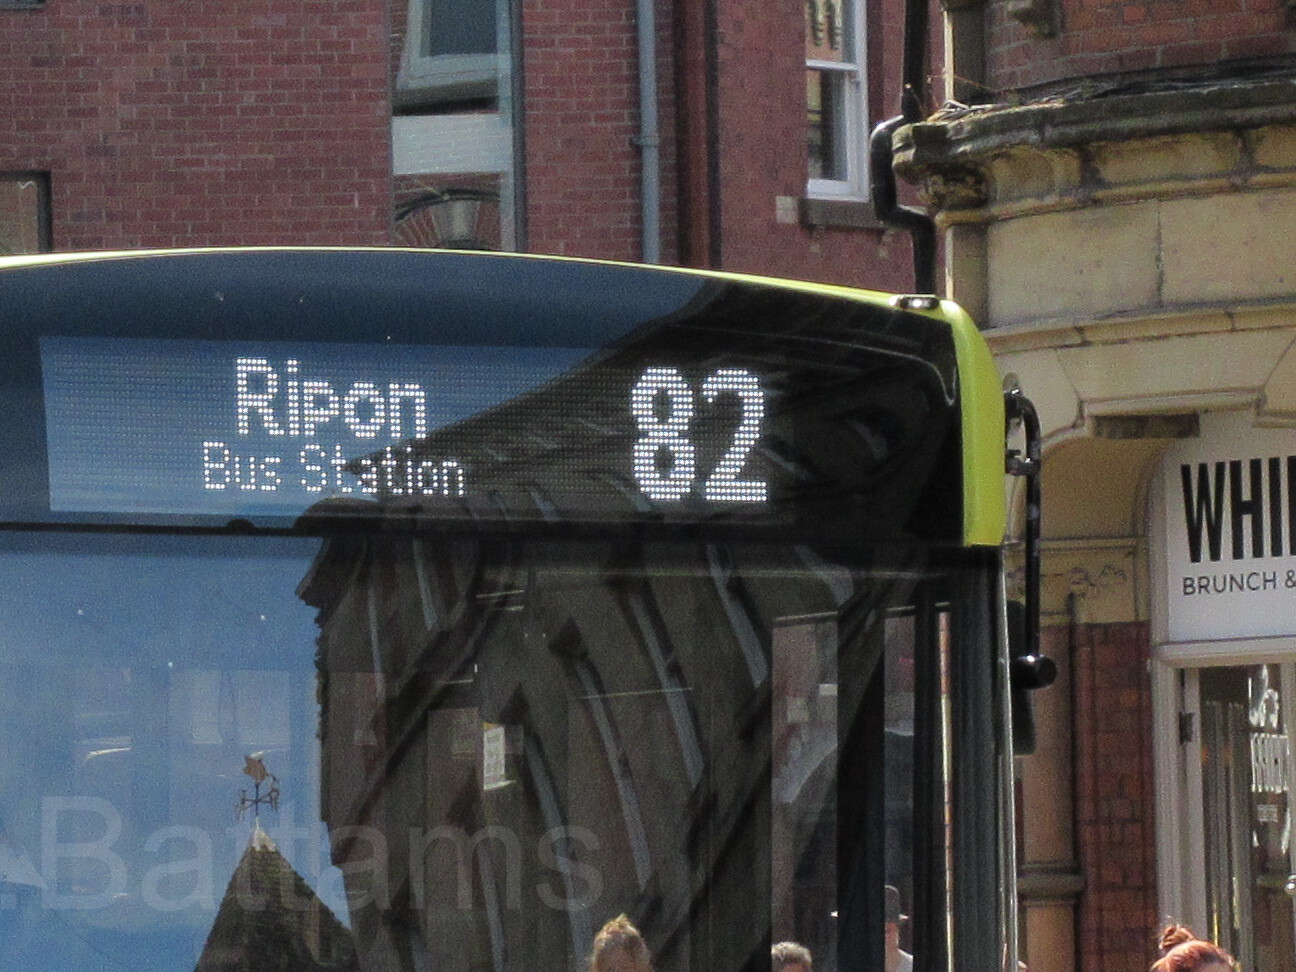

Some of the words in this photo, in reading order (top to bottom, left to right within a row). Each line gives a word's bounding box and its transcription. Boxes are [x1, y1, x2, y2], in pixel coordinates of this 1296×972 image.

[235, 357, 428, 440] Ripon
[203, 440, 282, 491] Bus
[300, 442, 465, 496] Station
[631, 367, 768, 502] 82
[1183, 570, 1277, 596] BRUNCH
